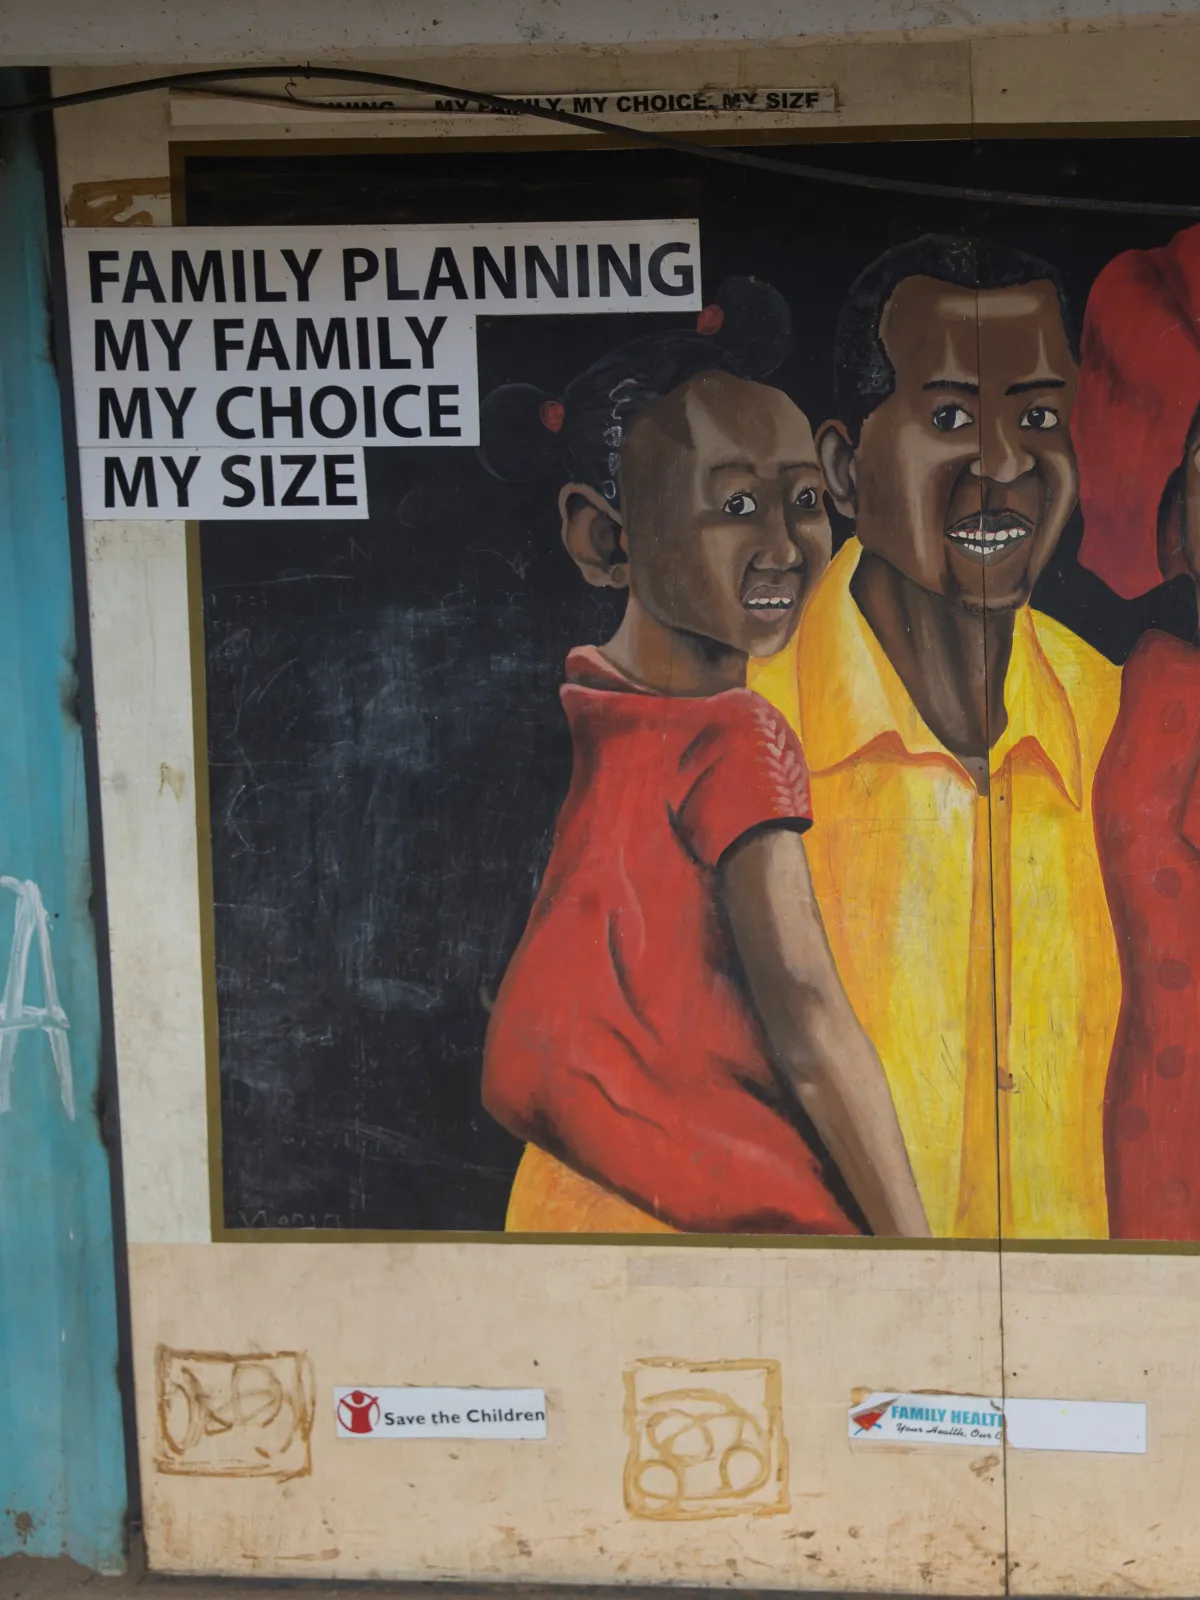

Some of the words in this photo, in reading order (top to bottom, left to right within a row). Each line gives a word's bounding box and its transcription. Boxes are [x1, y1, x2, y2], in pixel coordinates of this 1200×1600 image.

[573, 96, 609, 113] MY
[87, 249, 323, 304] FAMILY
[342, 241, 695, 302] PLANNING
[94, 318, 194, 372] MY
[213, 316, 448, 371] FAMILY
[98, 387, 197, 440] MY
[215, 384, 463, 440] CHOICE
[104, 455, 202, 509] MY
[221, 454, 359, 508] SIZE
[384, 1412, 426, 1426] Save
[431, 1410, 461, 1424] the
[466, 1408, 546, 1423] Children
[891, 1405, 948, 1424] FAMILY
